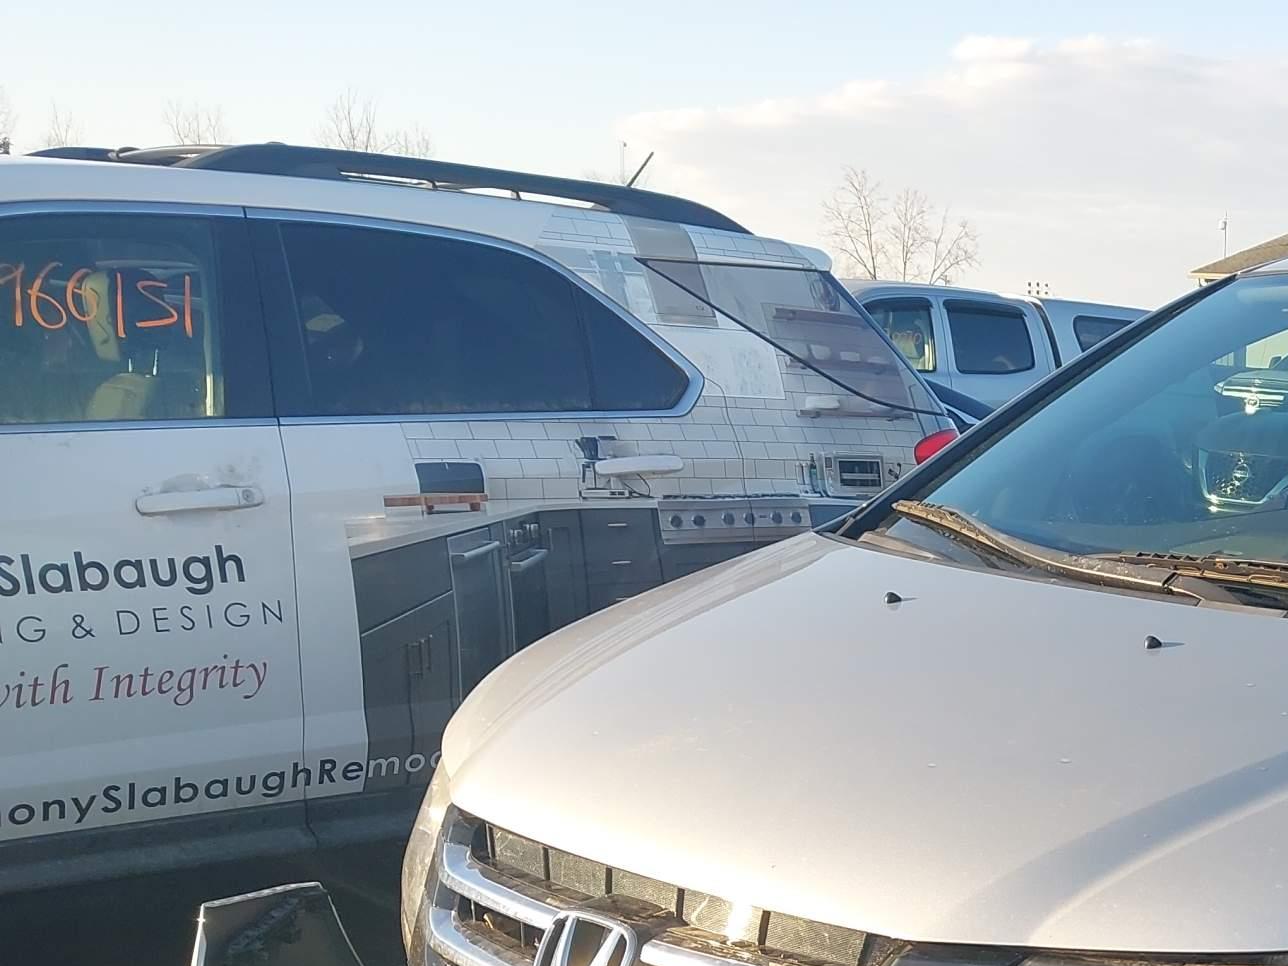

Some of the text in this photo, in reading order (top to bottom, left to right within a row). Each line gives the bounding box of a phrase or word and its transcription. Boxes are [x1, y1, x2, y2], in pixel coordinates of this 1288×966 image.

[0, 545, 246, 597] Slabaugh
[71, 614, 96, 640] &
[116, 599, 283, 636] DESIGN
[89, 654, 268, 706] Integrity
[0, 750, 442, 827] onySlabaughRemo
